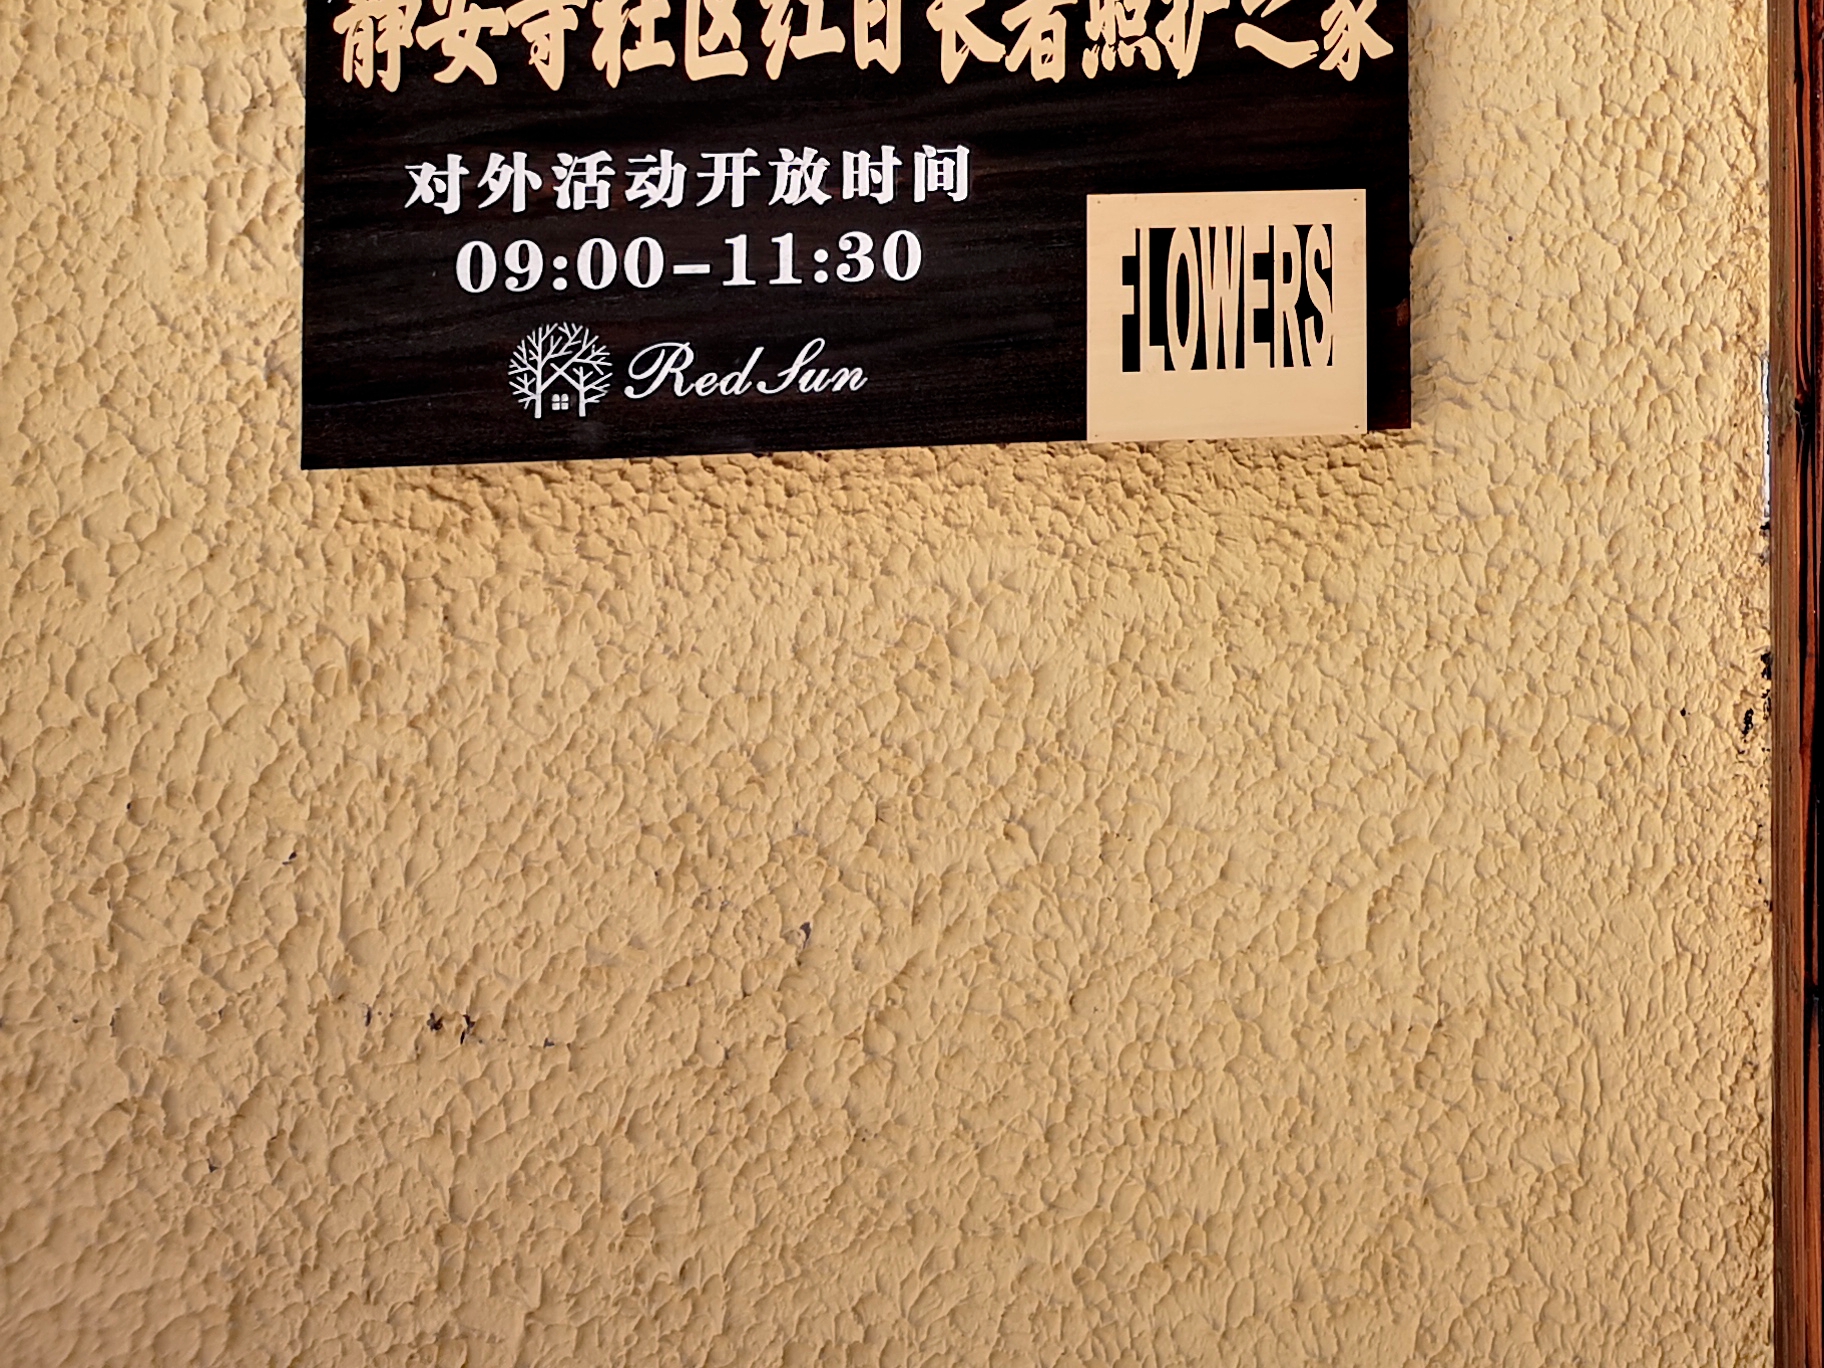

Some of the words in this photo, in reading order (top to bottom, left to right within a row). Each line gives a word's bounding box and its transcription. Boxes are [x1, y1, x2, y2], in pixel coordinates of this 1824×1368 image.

[404, 143, 971, 216] 对外活动开放时间
[455, 228, 923, 294] 09:00-11:30
[1113, 224, 1334, 373] FLOWERS
[623, 341, 765, 399] Red
[756, 337, 869, 395] Sun
